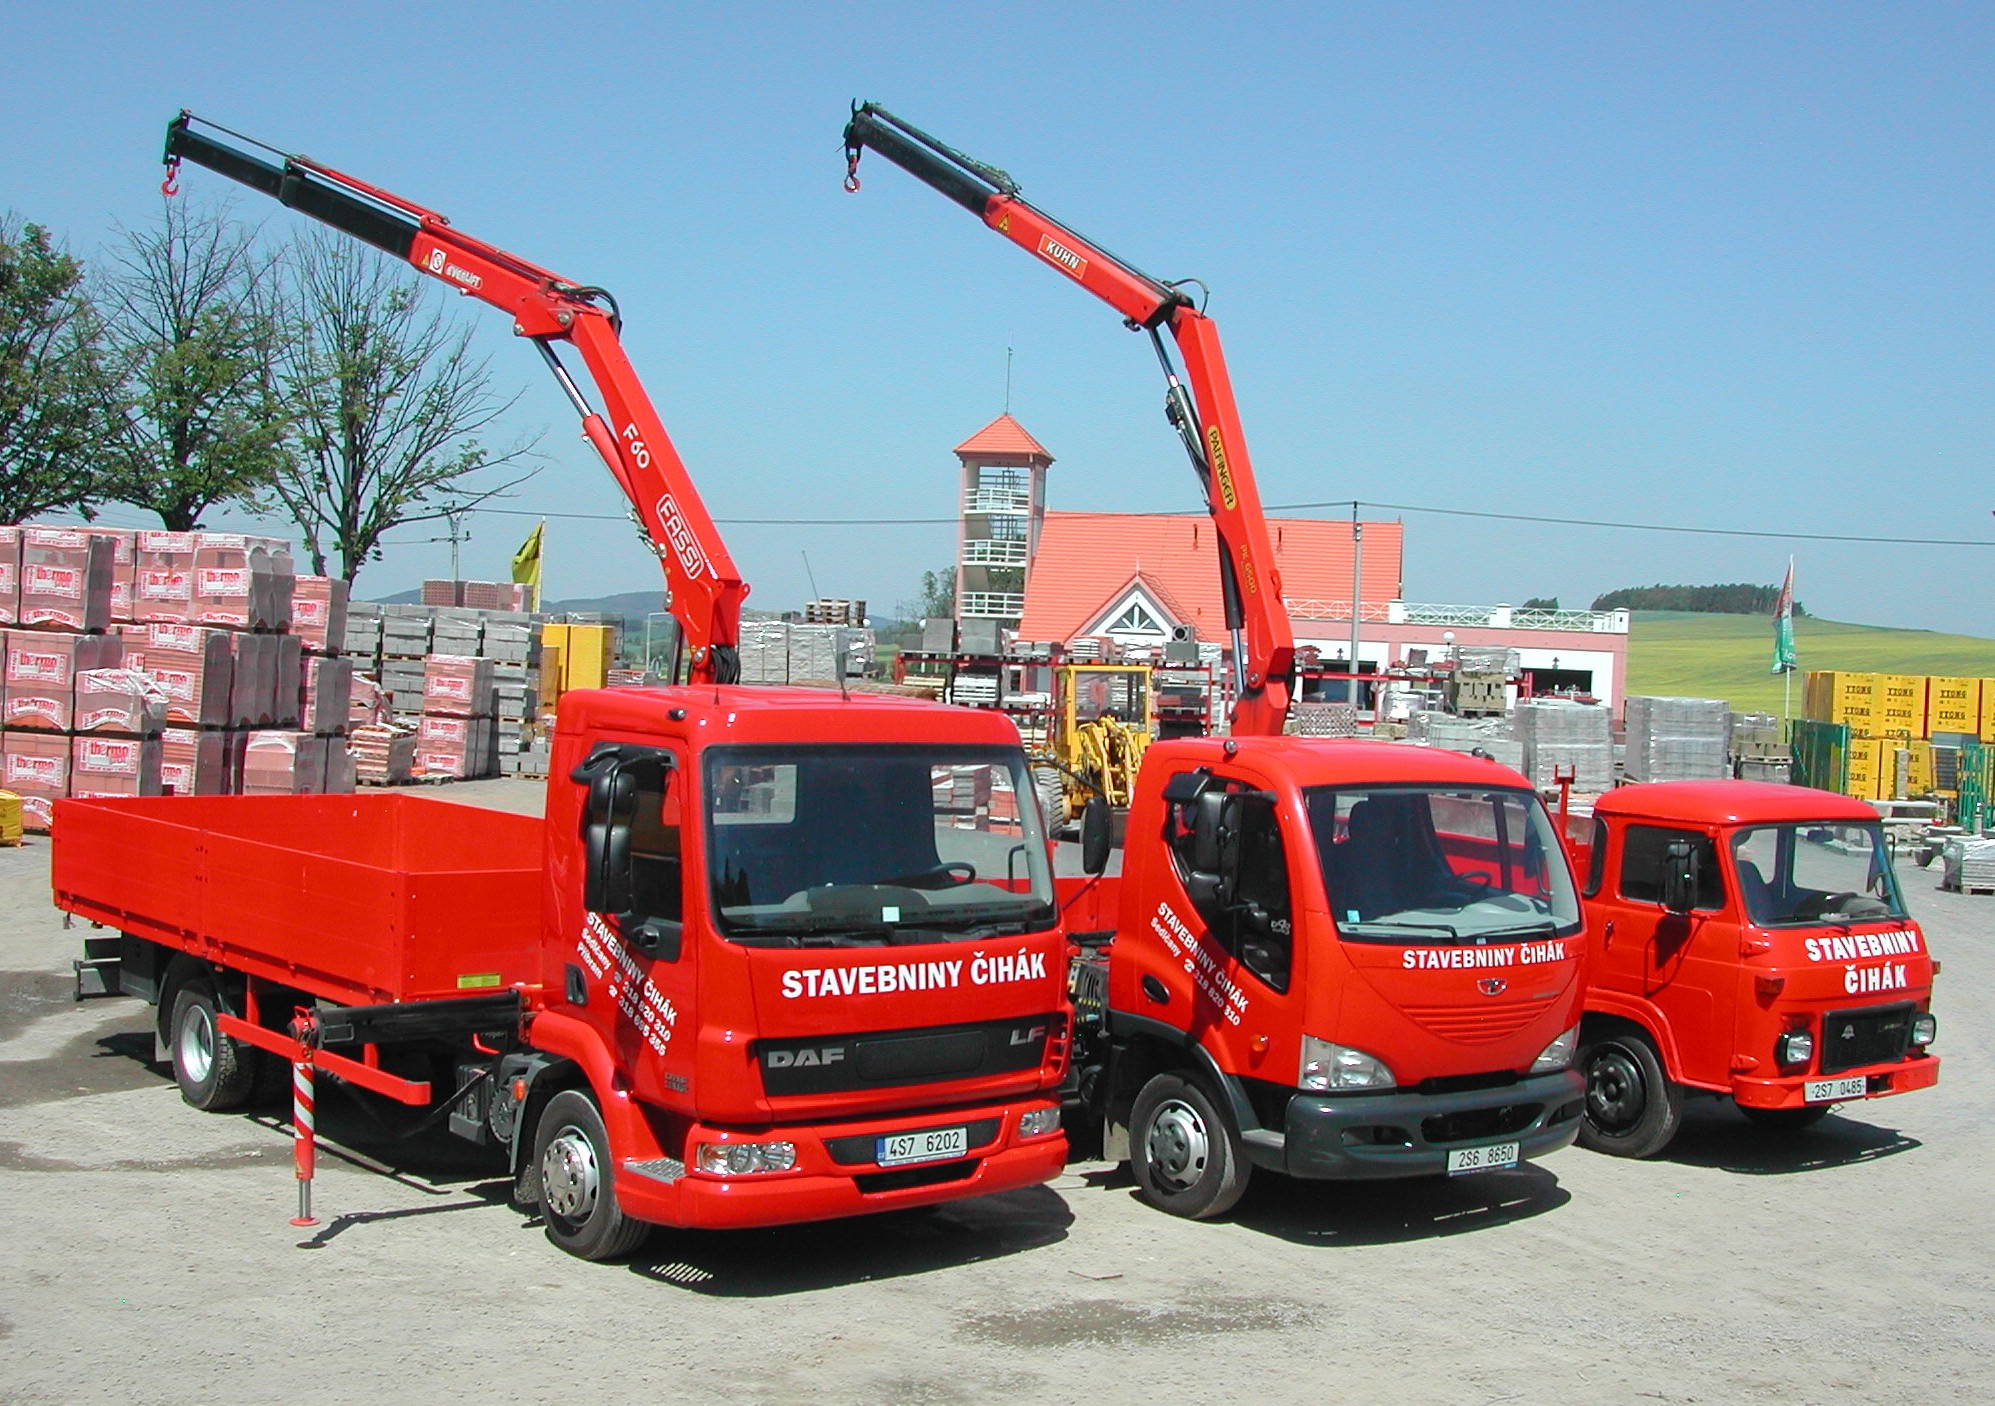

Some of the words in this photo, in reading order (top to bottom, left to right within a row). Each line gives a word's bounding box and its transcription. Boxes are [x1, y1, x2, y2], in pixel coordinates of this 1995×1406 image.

[1046, 240, 1080, 269] KUHN
[1209, 430, 1235, 505] PALFINGER
[659, 501, 700, 573] FASSI
[1157, 902, 1216, 973] STAVEBNINY
[1215, 968, 1248, 1013] ČIHÁK
[1402, 948, 1515, 969] STAVEBNINY
[1520, 940, 1565, 965] ČIHÁK
[1805, 930, 1919, 962] STAVEBNINY
[581, 927, 612, 970] Sedlčany
[653, 1018, 671, 1042] 310
[586, 912, 645, 984] STAVEBNINY
[643, 976, 678, 1027] ČIHÁK
[782, 961, 963, 998] STAVEBNINY
[970, 947, 1047, 986] ČIHÁK
[1151, 917, 1181, 957] Sedlčany
[1223, 1005, 1240, 1026] 310
[1844, 961, 1907, 994] ČIHÁK
[1009, 1026, 1046, 1046] LF
[768, 1048, 845, 1068] DAF
[1815, 1083, 1833, 1099] 2S7
[1840, 1079, 1863, 1096] 0485
[890, 1137, 915, 1157] 4S7
[926, 1131, 959, 1152] 6202
[1459, 1150, 1480, 1168] 2S6
[1487, 1145, 1514, 1164] 8650
